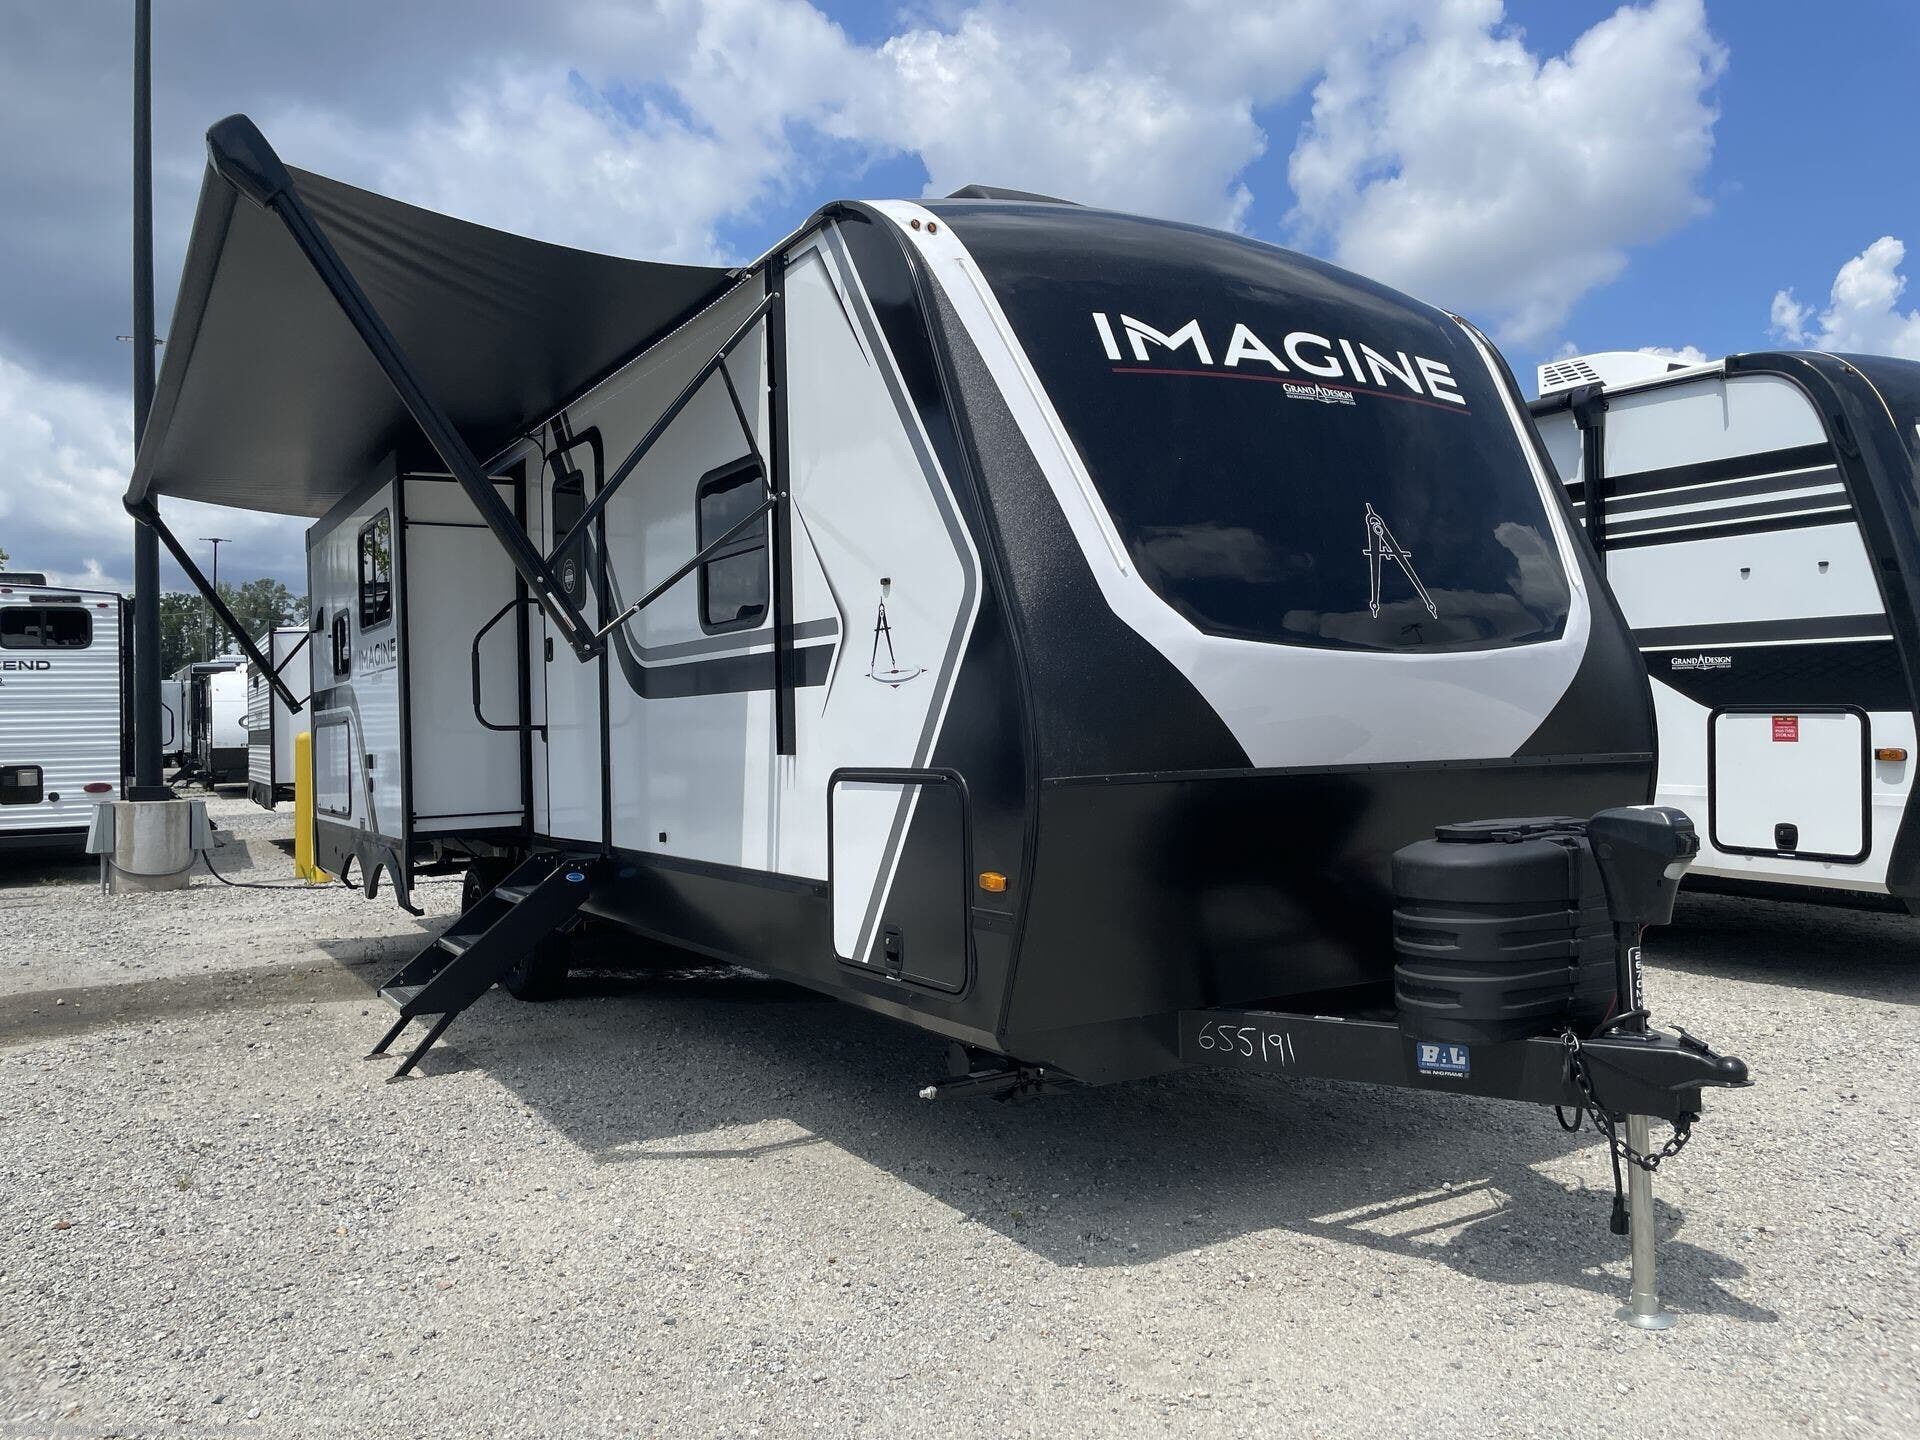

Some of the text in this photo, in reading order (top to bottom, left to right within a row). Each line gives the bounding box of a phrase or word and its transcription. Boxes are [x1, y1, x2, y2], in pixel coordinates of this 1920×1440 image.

[1092, 312, 1467, 405] IMAGINE
[1282, 383, 1354, 400] GRAND DESIGN
[358, 638, 397, 671] IMAGINE
[1671, 656, 1732, 665] GRAND DESIGN
[0, 661, 51, 671] END
[1198, 1020, 1296, 1068] 655191
[1421, 1045, 1466, 1065] BAL
